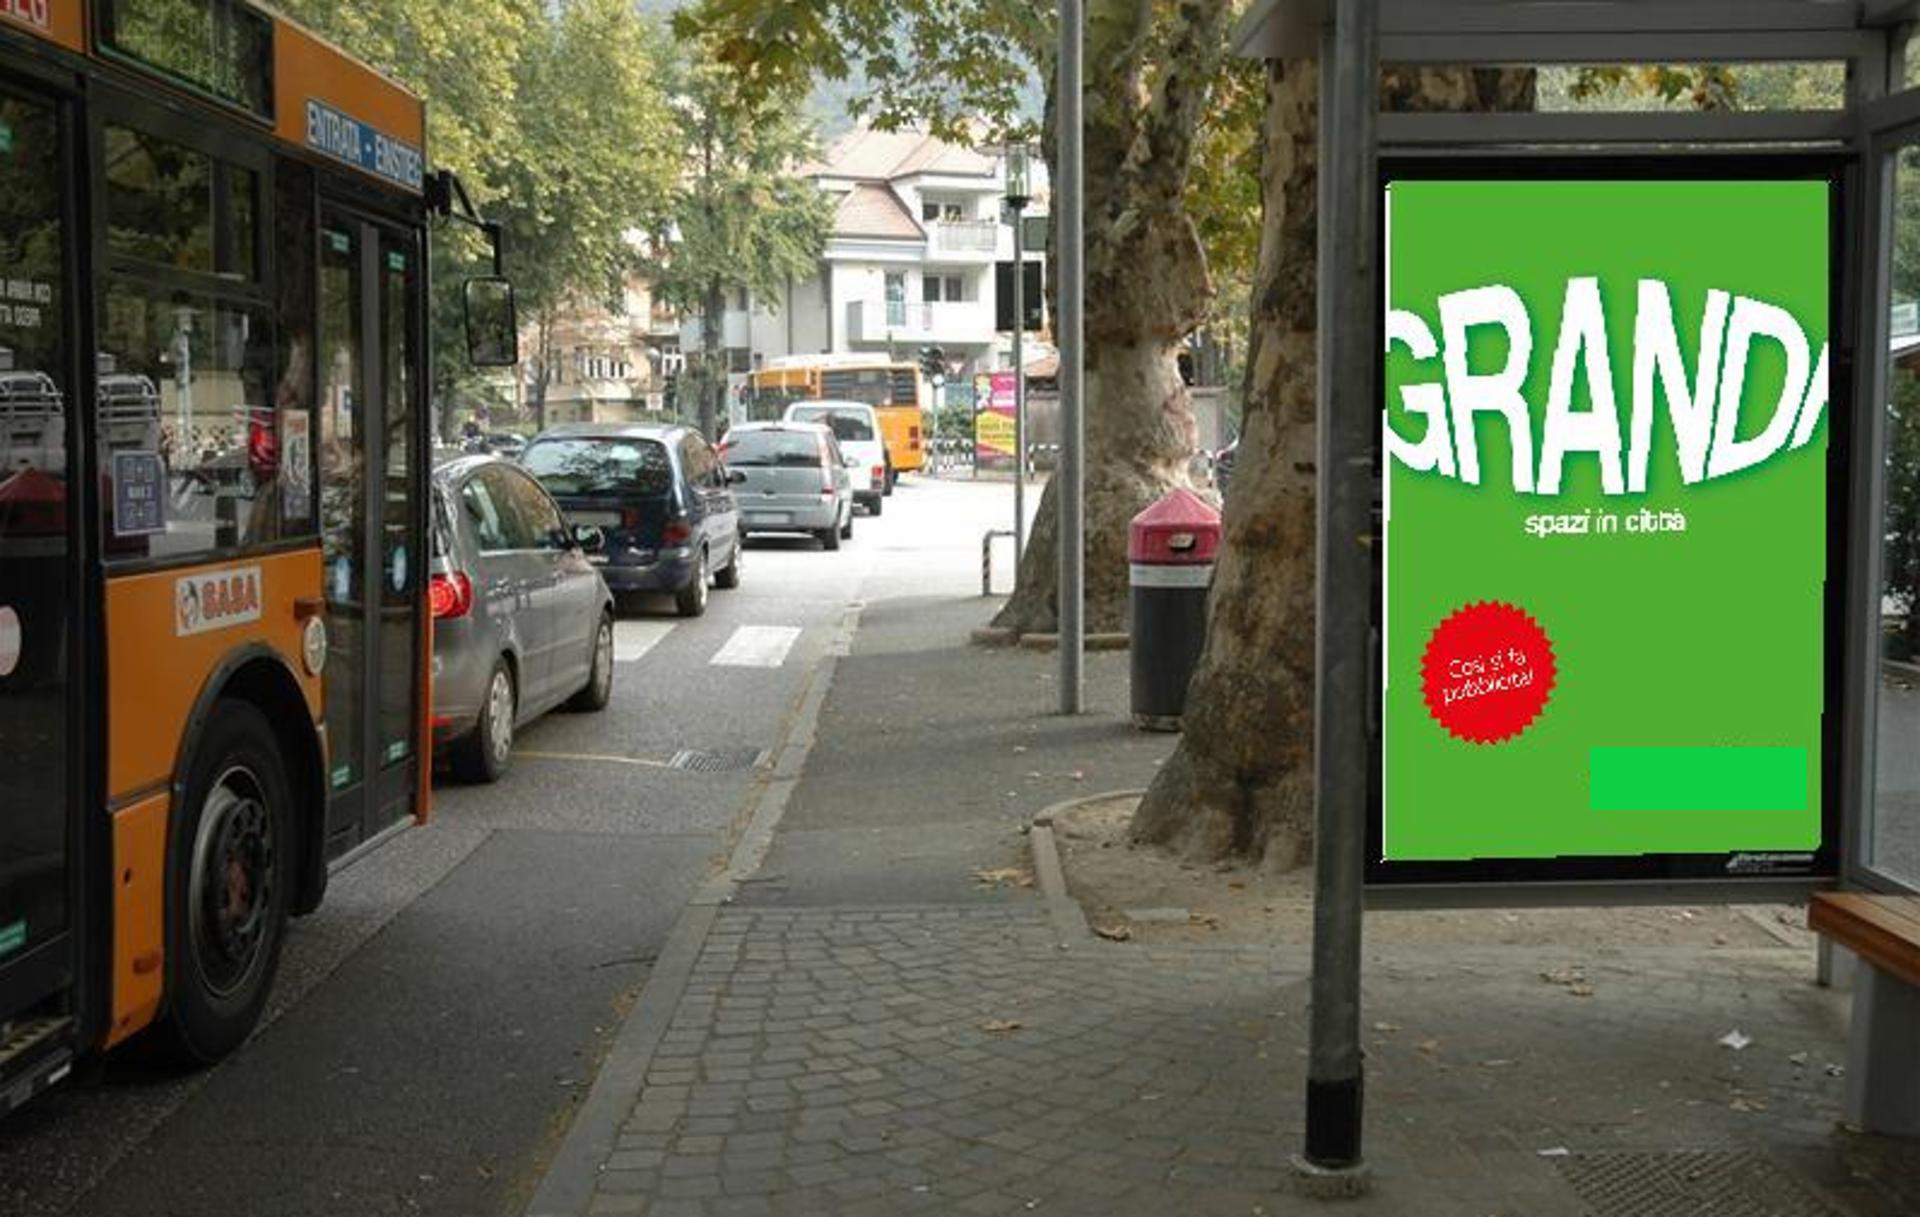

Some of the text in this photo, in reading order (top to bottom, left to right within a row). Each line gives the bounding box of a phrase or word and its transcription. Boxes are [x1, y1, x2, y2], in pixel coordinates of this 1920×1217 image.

[307, 101, 361, 163] ENTRATA
[1525, 508, 1590, 538] spazi
[1595, 508, 1617, 533] in
